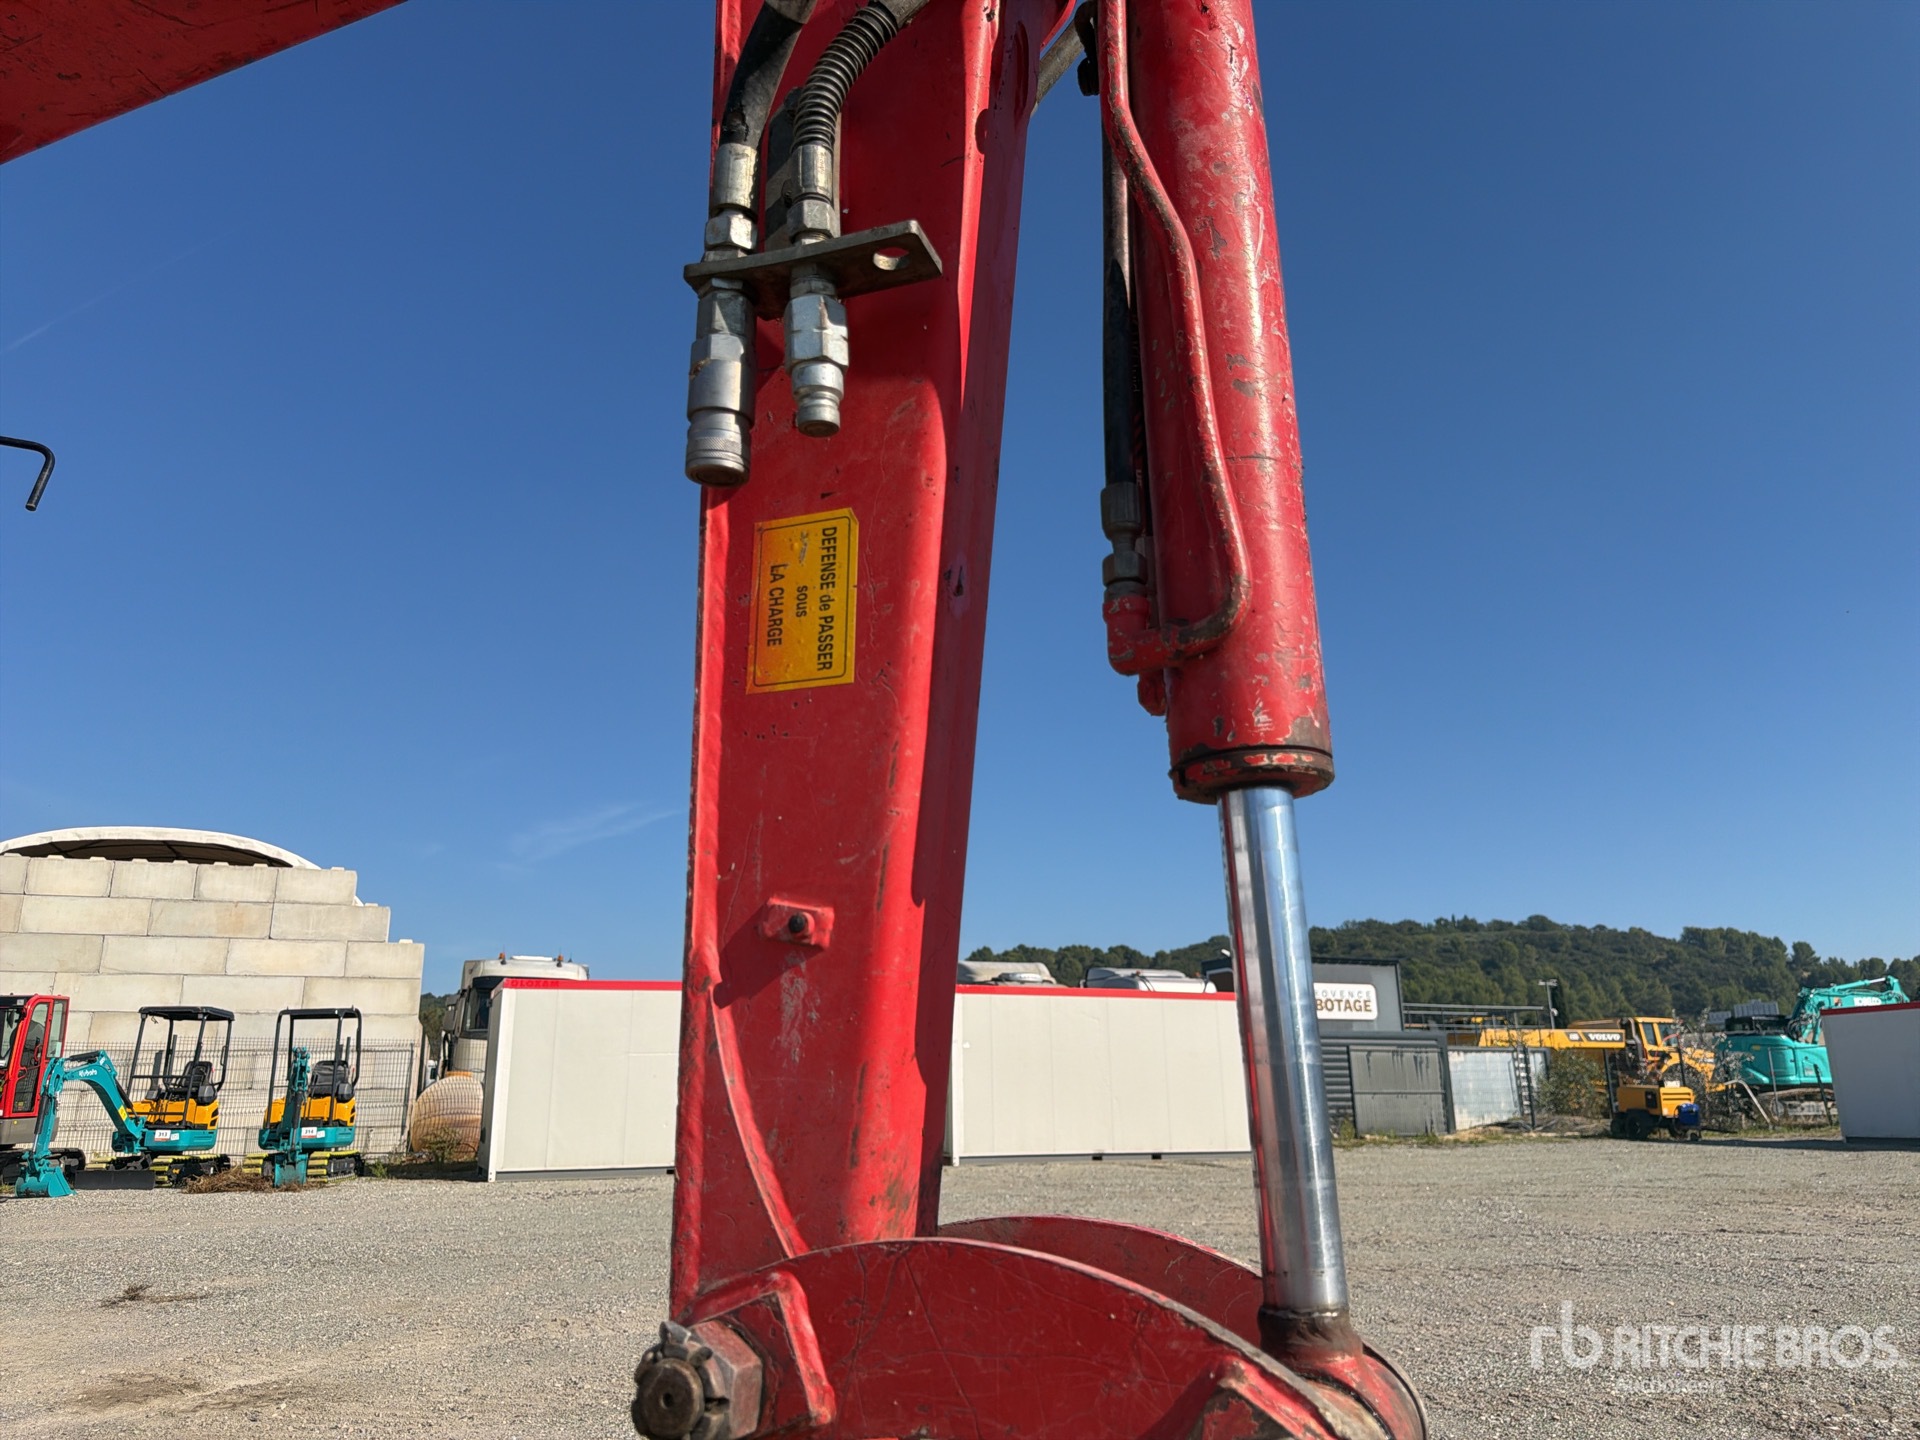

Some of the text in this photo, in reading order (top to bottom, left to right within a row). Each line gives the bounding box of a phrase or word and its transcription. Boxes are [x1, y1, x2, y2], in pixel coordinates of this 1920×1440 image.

[767, 563, 787, 647] LA CHARGE
[817, 526, 838, 671] DEFENSE de PASSER
[1587, 1032, 1621, 1041] VOLVO
